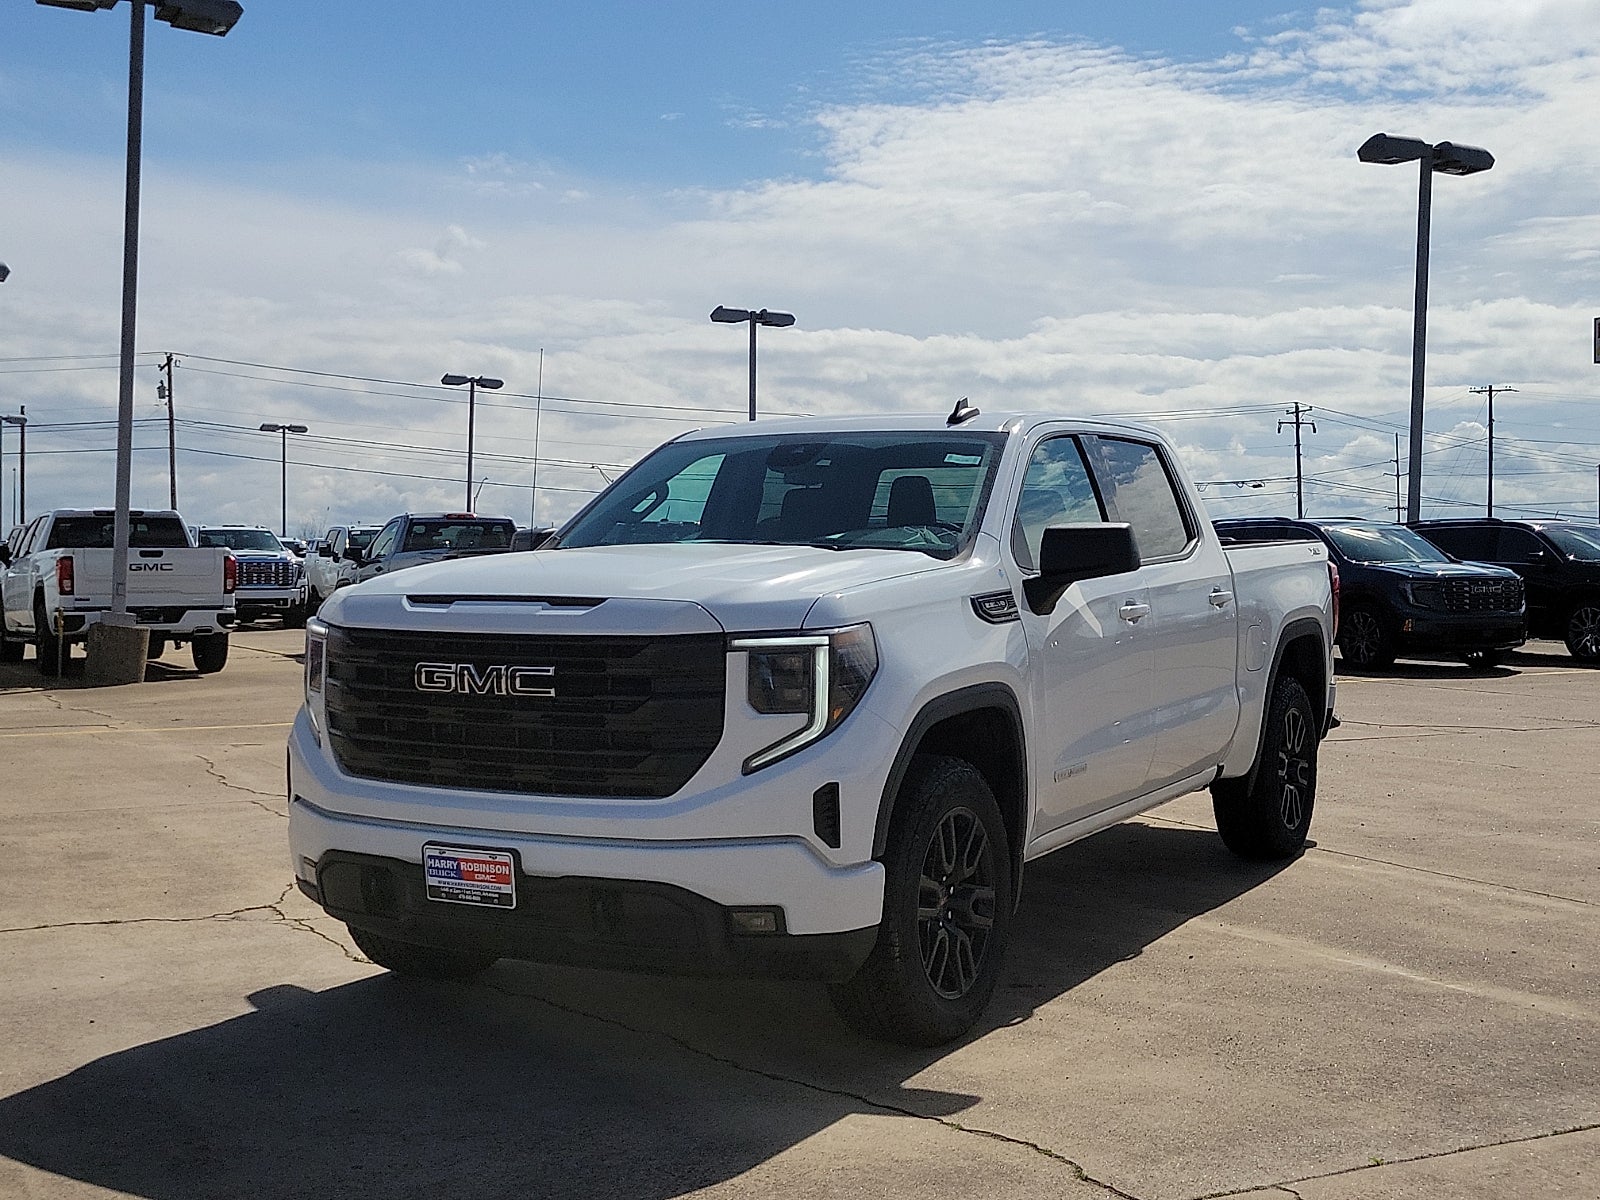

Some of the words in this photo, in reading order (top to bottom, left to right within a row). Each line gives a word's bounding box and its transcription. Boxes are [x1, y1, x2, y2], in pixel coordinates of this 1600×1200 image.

[129, 563, 173, 571] GMC
[414, 662, 555, 697] GMC
[428, 858, 458, 870] HARRY
[460, 861, 510, 875] ROBINSON
[429, 868, 458, 878] BUICK
[474, 873, 497, 881] GMC
